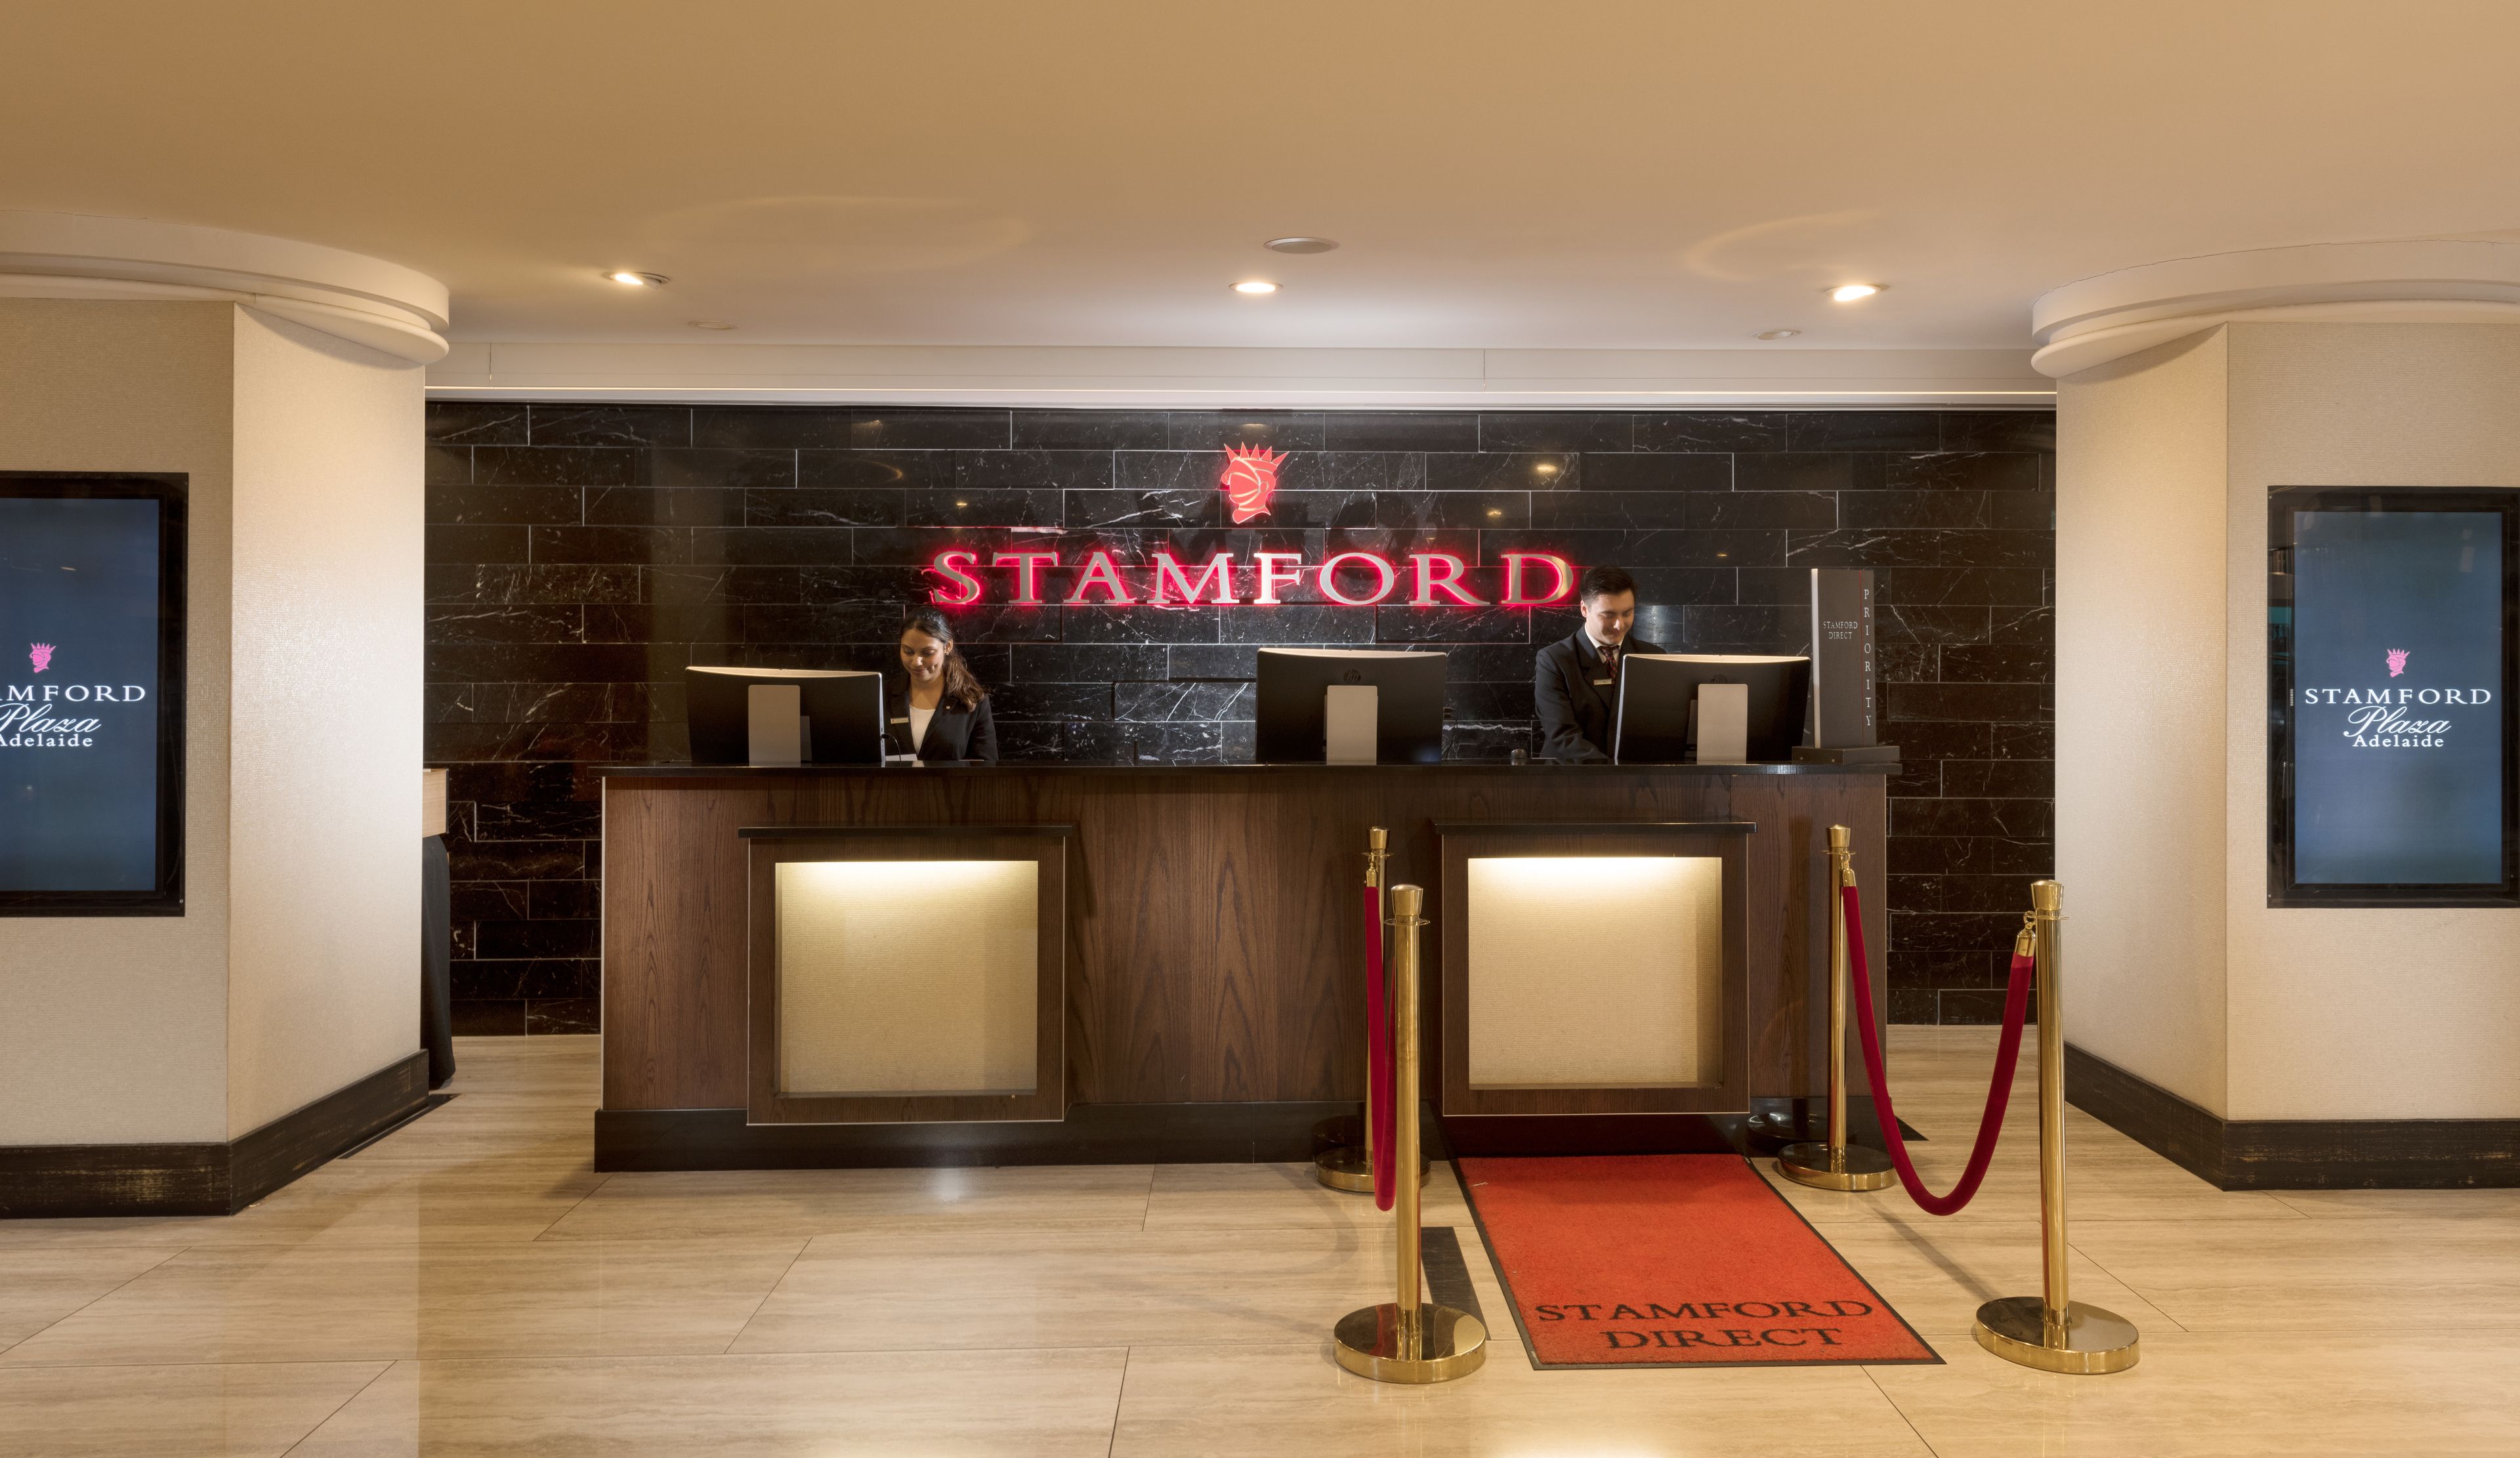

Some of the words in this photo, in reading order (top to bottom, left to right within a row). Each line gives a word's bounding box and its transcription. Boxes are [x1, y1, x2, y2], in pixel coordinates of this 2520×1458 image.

[934, 551, 1574, 605] STAMFORD
[1822, 621, 1858, 630] STAMFORD
[1828, 631, 1853, 640] DIRECT
[0, 684, 146, 703] MFORD
[2305, 688, 2492, 705] STAMFORD
[0, 703, 102, 733] Plaza
[2343, 705, 2452, 738] Plaza
[0, 733, 93, 747] Adelaide
[2352, 734, 2444, 747] Adelaide
[1534, 1300, 1873, 1322] STAMFORD
[1599, 1328, 1842, 1349] DIRECT
